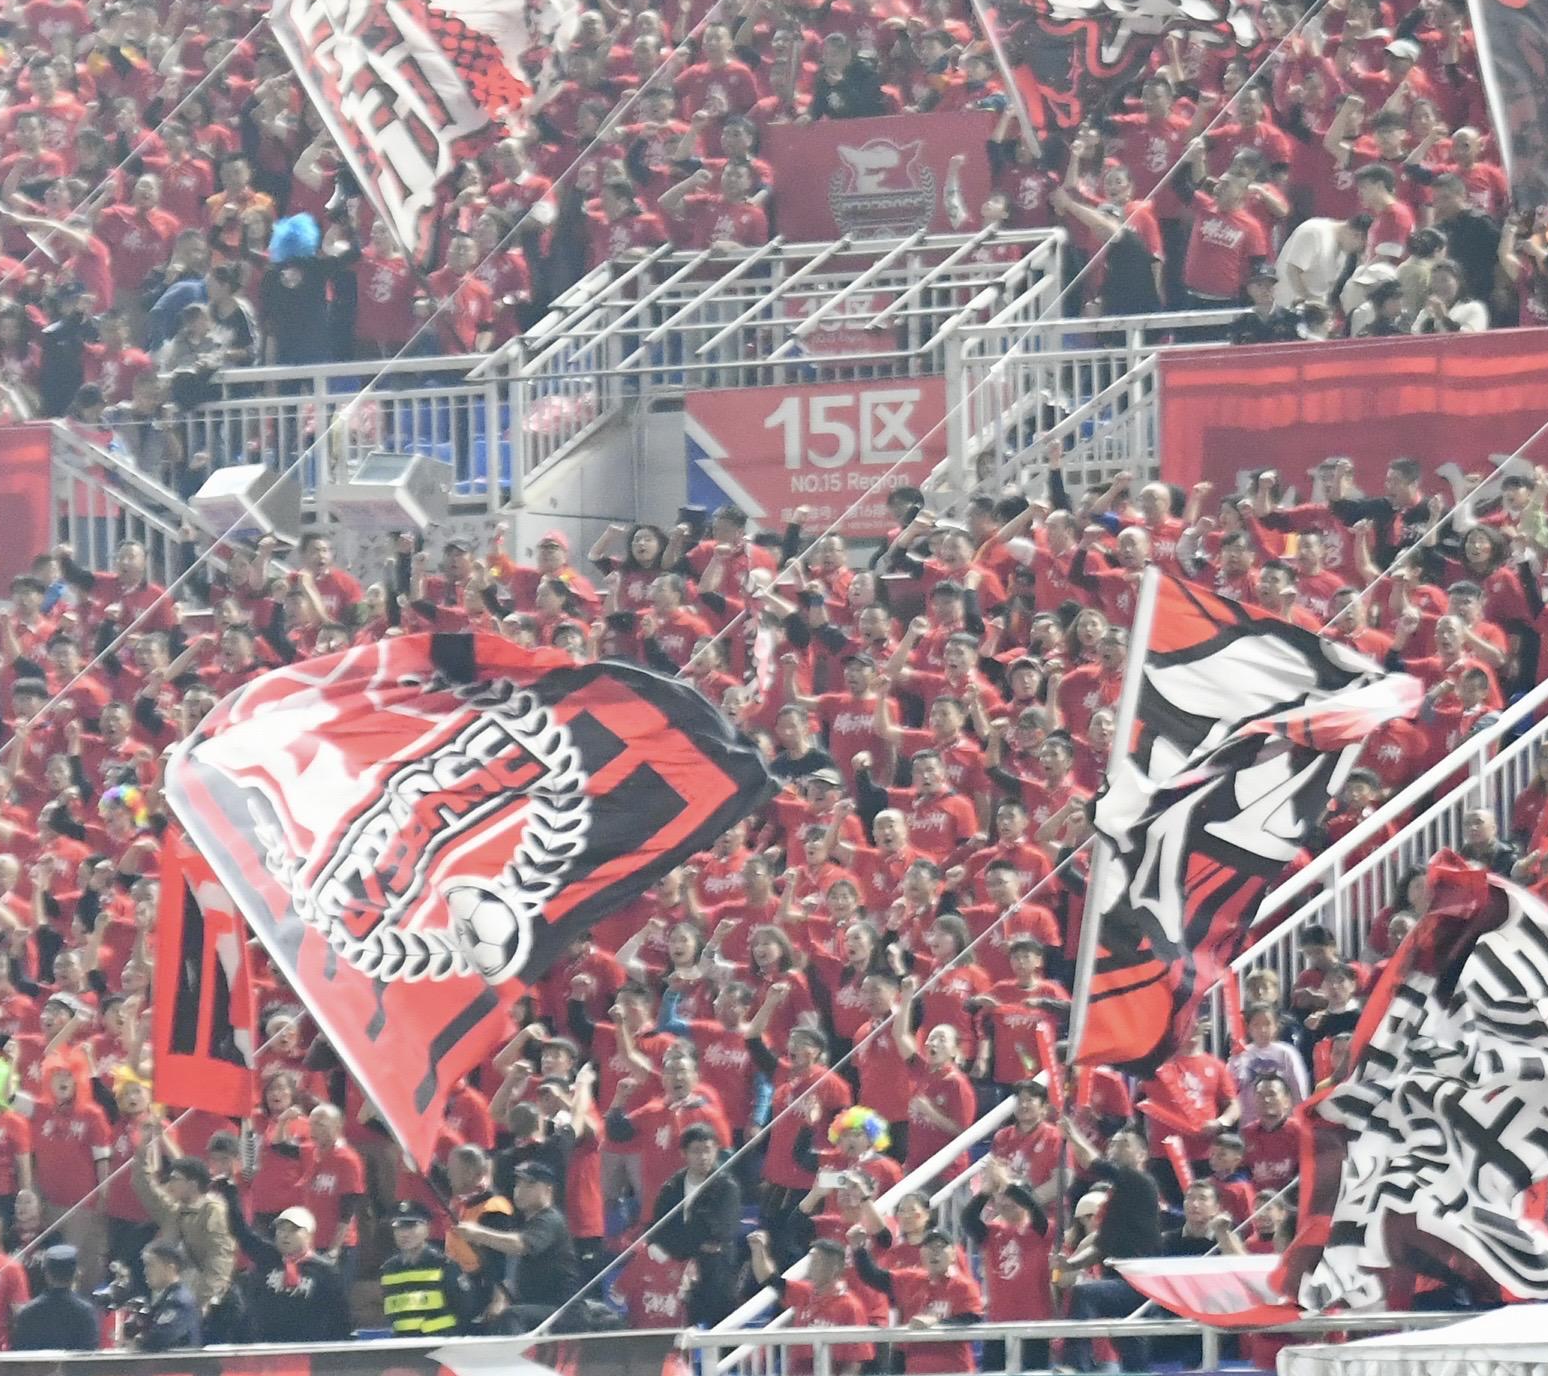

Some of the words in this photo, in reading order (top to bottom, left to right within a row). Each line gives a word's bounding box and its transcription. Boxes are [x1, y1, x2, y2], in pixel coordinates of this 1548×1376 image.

[763, 388, 923, 470] 15区
[790, 473, 843, 494] NO.15
[846, 472, 911, 496] Region
